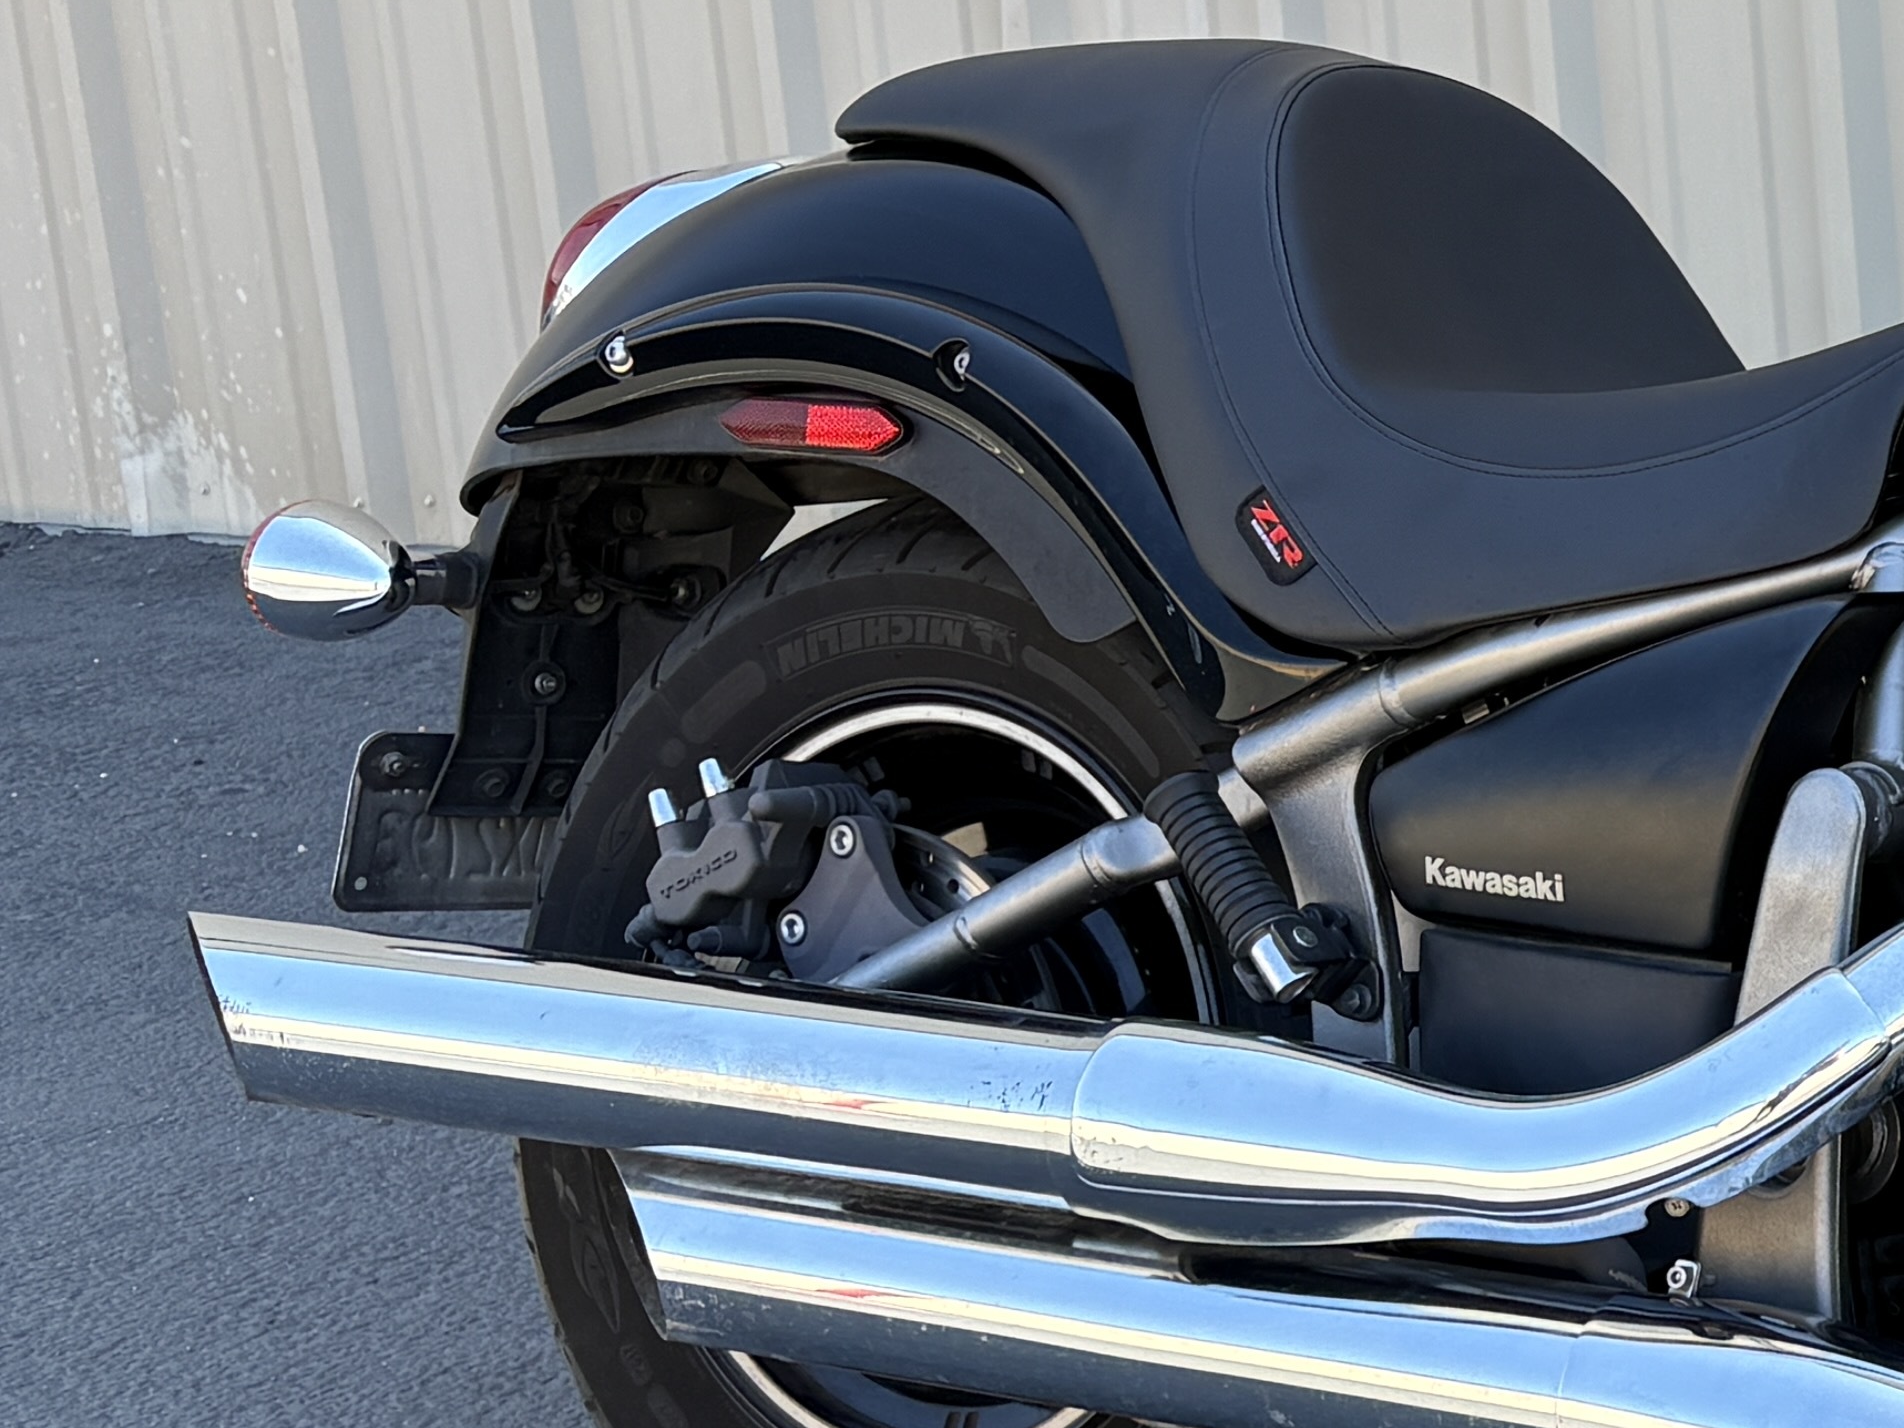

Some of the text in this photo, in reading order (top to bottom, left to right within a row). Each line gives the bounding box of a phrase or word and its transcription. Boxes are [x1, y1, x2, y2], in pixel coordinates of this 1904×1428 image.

[776, 614, 966, 677] MICHELIN
[660, 847, 740, 901] TOKICO
[1424, 855, 1565, 902] Kawasaki
